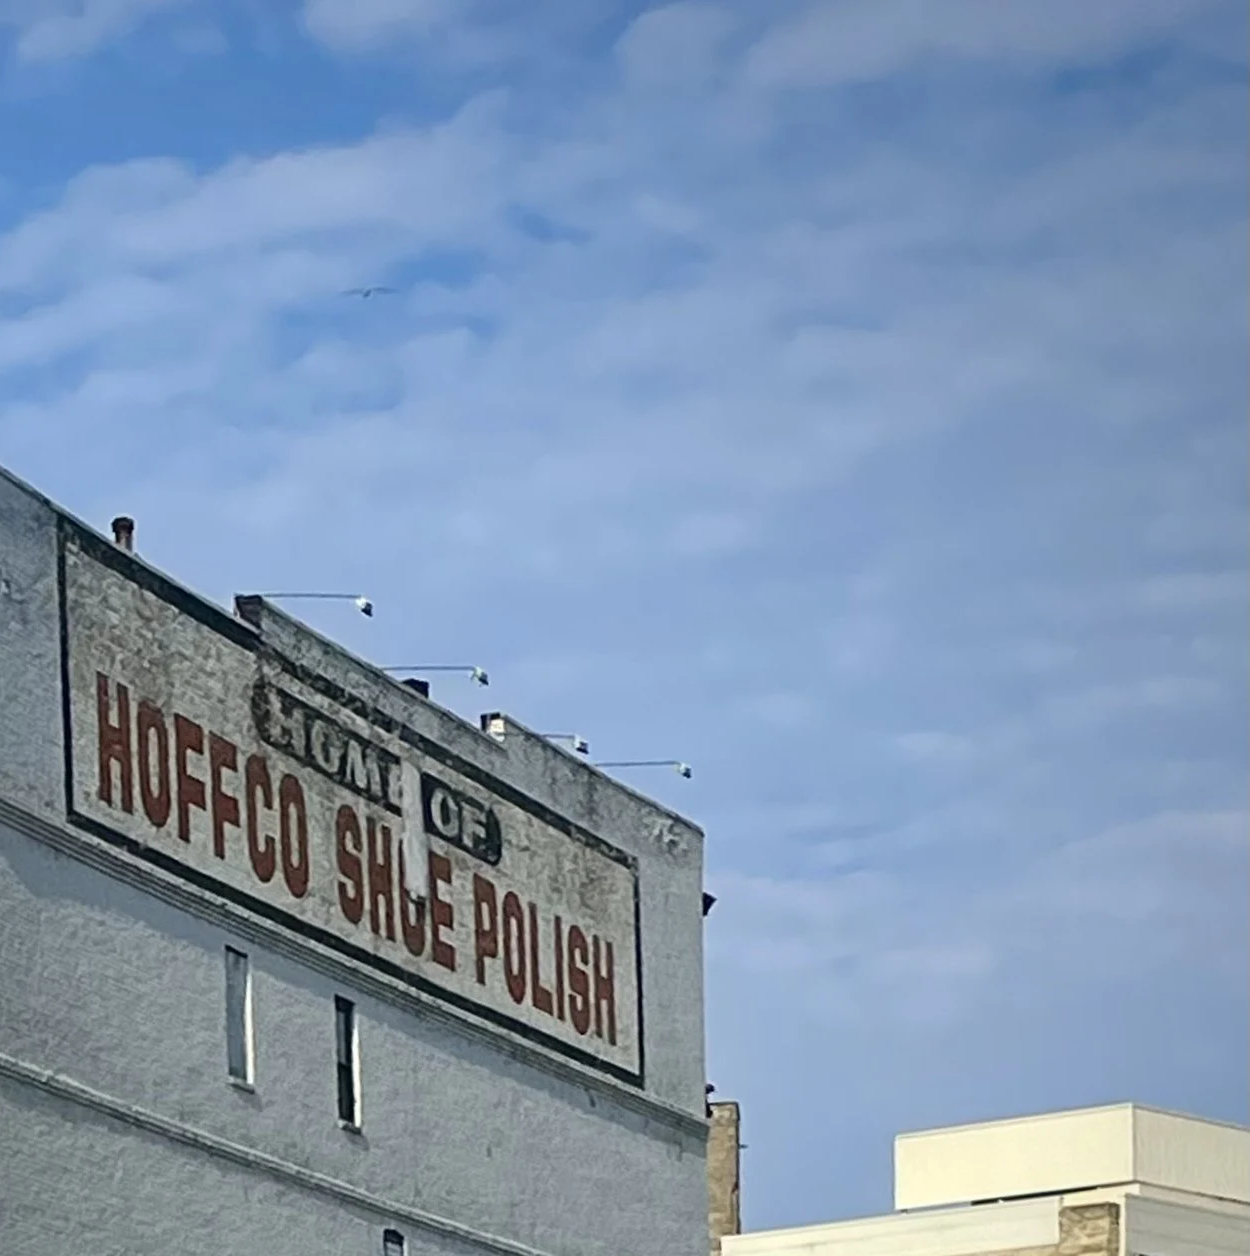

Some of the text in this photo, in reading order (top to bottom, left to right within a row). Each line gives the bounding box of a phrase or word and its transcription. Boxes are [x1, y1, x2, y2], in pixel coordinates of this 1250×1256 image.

[96, 671, 617, 1046] HOFFCO SHOE POLISH
[431, 788, 488, 852] OF
